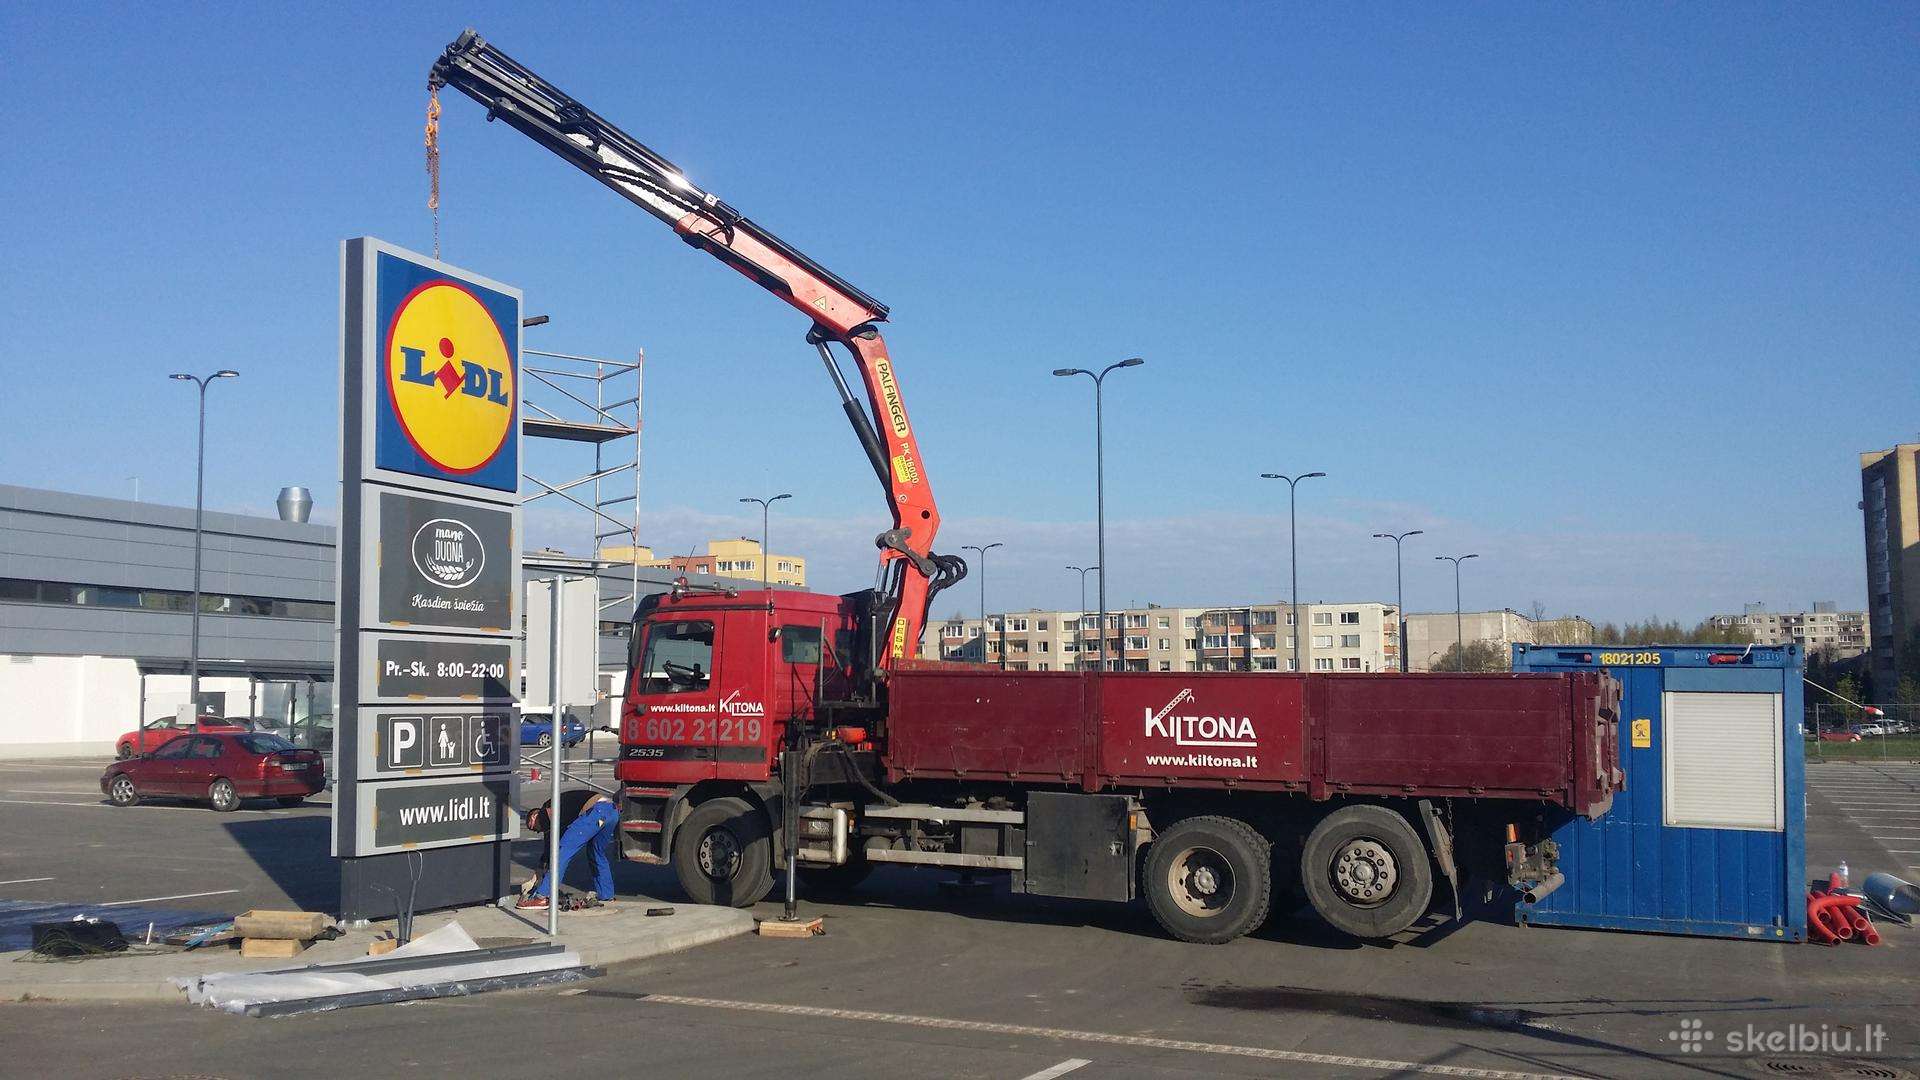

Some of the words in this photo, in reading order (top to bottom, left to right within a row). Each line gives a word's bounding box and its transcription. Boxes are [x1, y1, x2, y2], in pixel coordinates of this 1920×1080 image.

[878, 362, 907, 433] PALFINGER
[435, 528, 465, 541] mano
[434, 540, 464, 563] DUONA
[411, 594, 452, 610] Kasdien
[650, 703, 716, 713] www.kiltona.lt
[628, 719, 640, 740] 8
[646, 719, 685, 741] 602
[692, 719, 761, 741] 21219
[393, 721, 416, 764] P
[628, 748, 665, 757] 2535
[1146, 754, 1258, 768] www.kiltona.lt
[400, 796, 490, 826] www.lidl.lt
